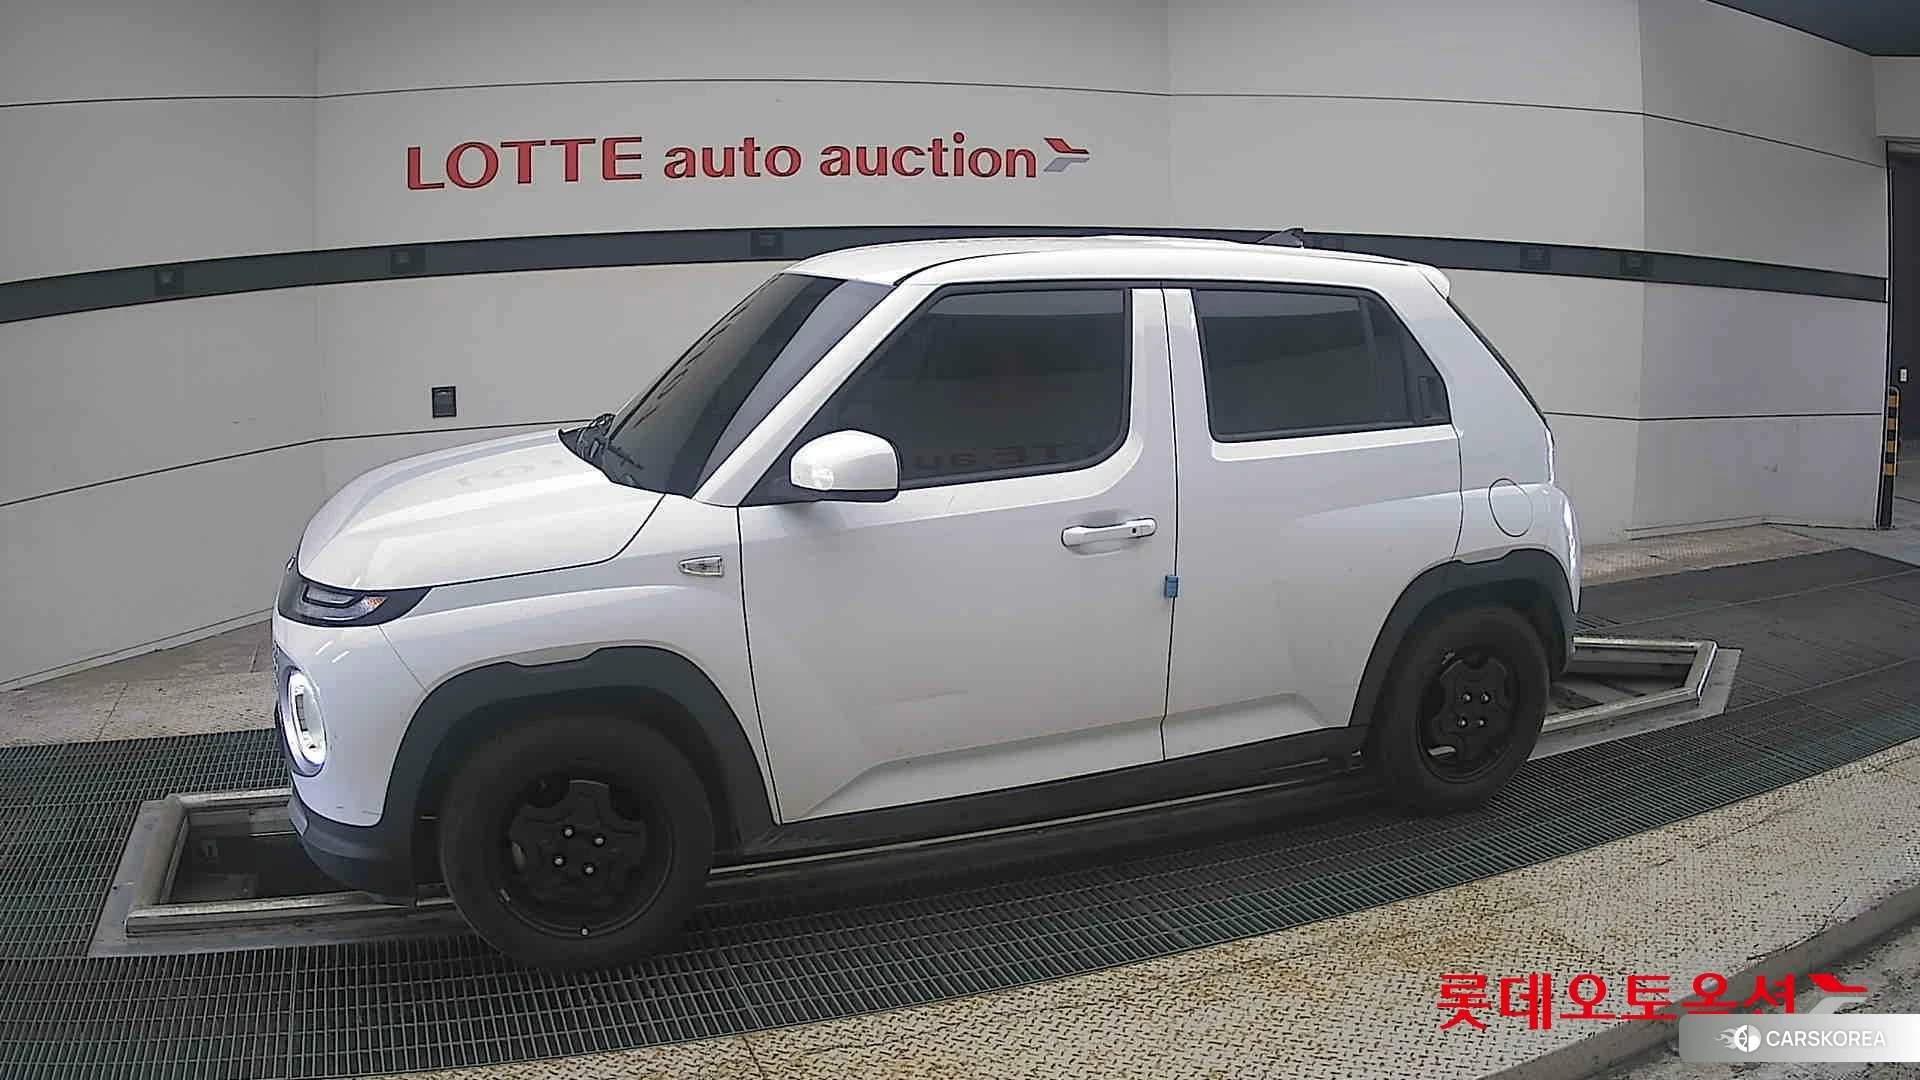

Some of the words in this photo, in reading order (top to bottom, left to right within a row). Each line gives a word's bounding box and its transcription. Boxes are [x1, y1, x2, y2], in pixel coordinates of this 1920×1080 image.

[407, 135, 643, 192] LOTTE
[663, 136, 803, 179] auto
[818, 131, 1038, 178] auction
